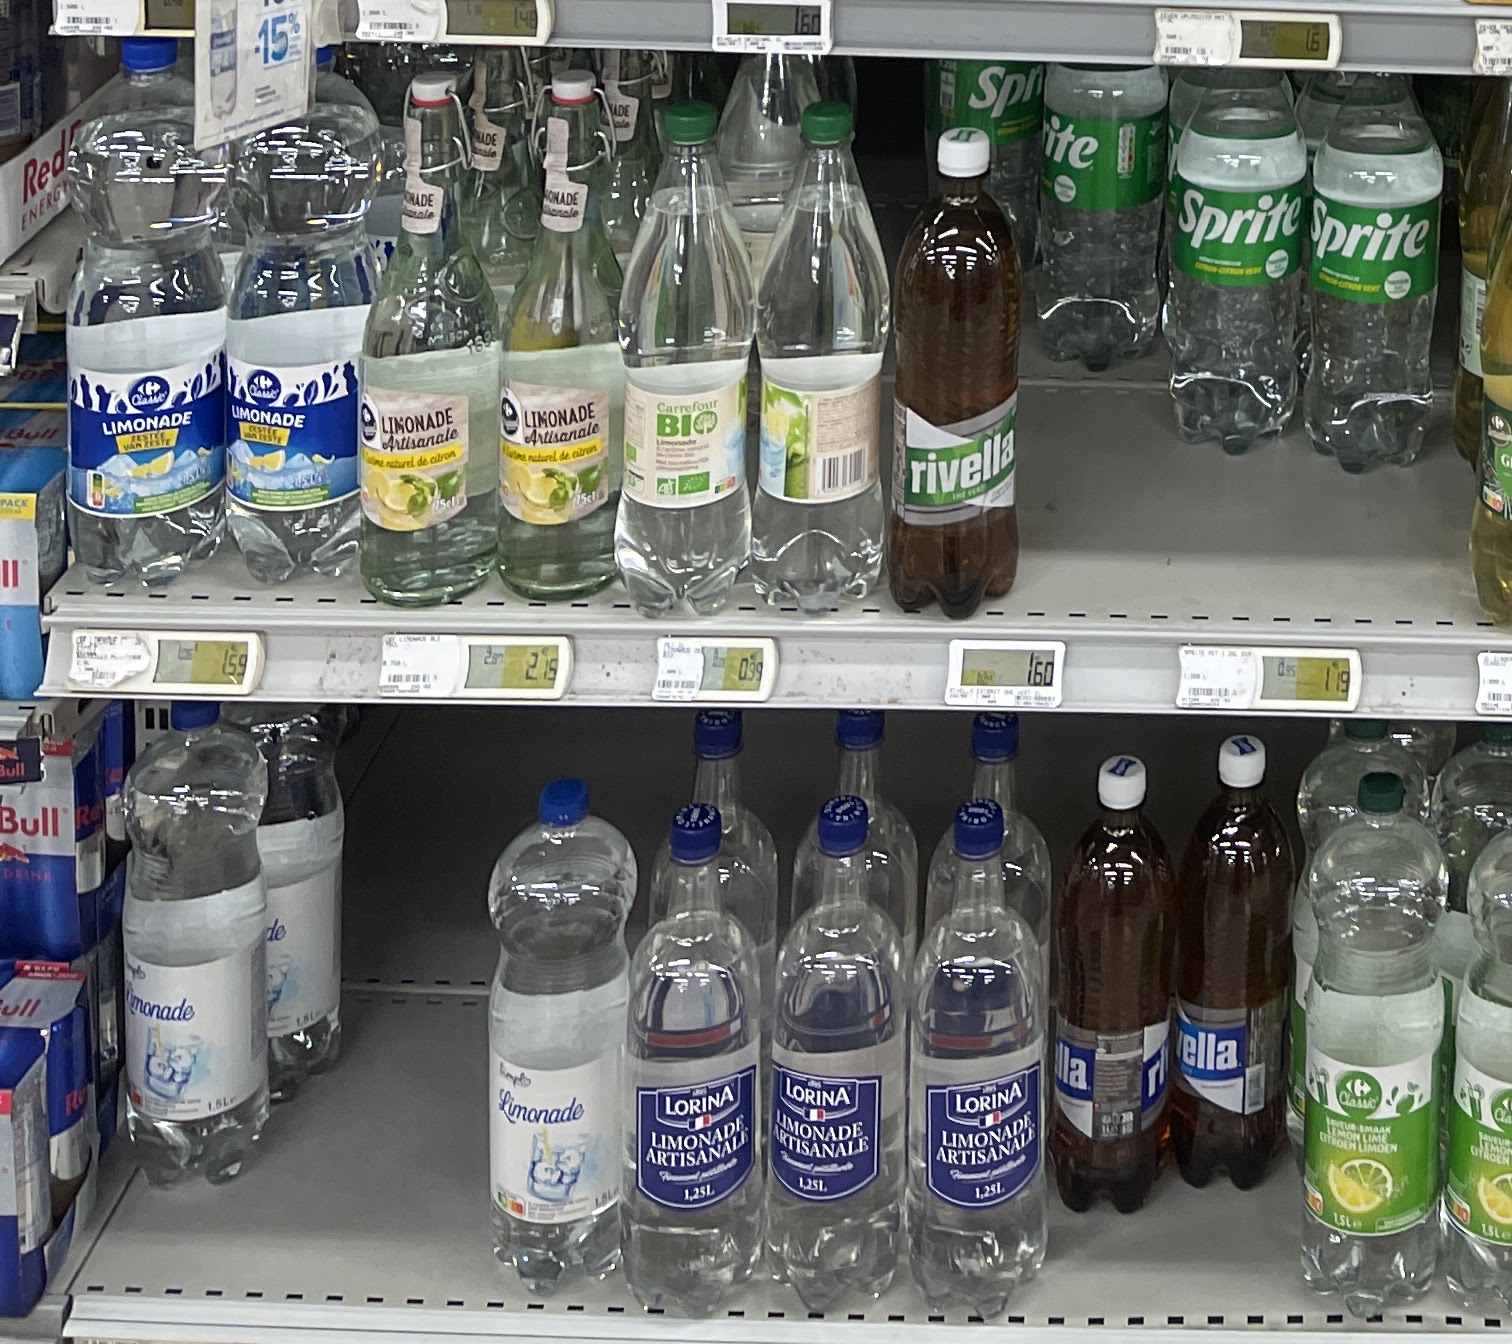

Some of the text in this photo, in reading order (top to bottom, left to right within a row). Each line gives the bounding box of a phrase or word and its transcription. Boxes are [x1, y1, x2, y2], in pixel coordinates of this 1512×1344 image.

[1179, 189, 1300, 249] Sprite
[1310, 198, 1429, 261] Sprite
[381, 407, 454, 434] LIMONADE
[524, 402, 595, 429] LIMONADE
[657, 400, 719, 414] Carrefour
[102, 411, 193, 433] LIMONADE
[524, 422, 599, 444] Artisanale
[382, 428, 459, 452] Artisanale
[430, 450, 457, 464] citron
[910, 431, 1016, 494] rivella
[499, 1089, 584, 1124] Limonade
[664, 1085, 735, 1117] LORINA
[645, 1128, 749, 1166] ARTISANALE
[650, 1117, 743, 1152] LIMONADE
